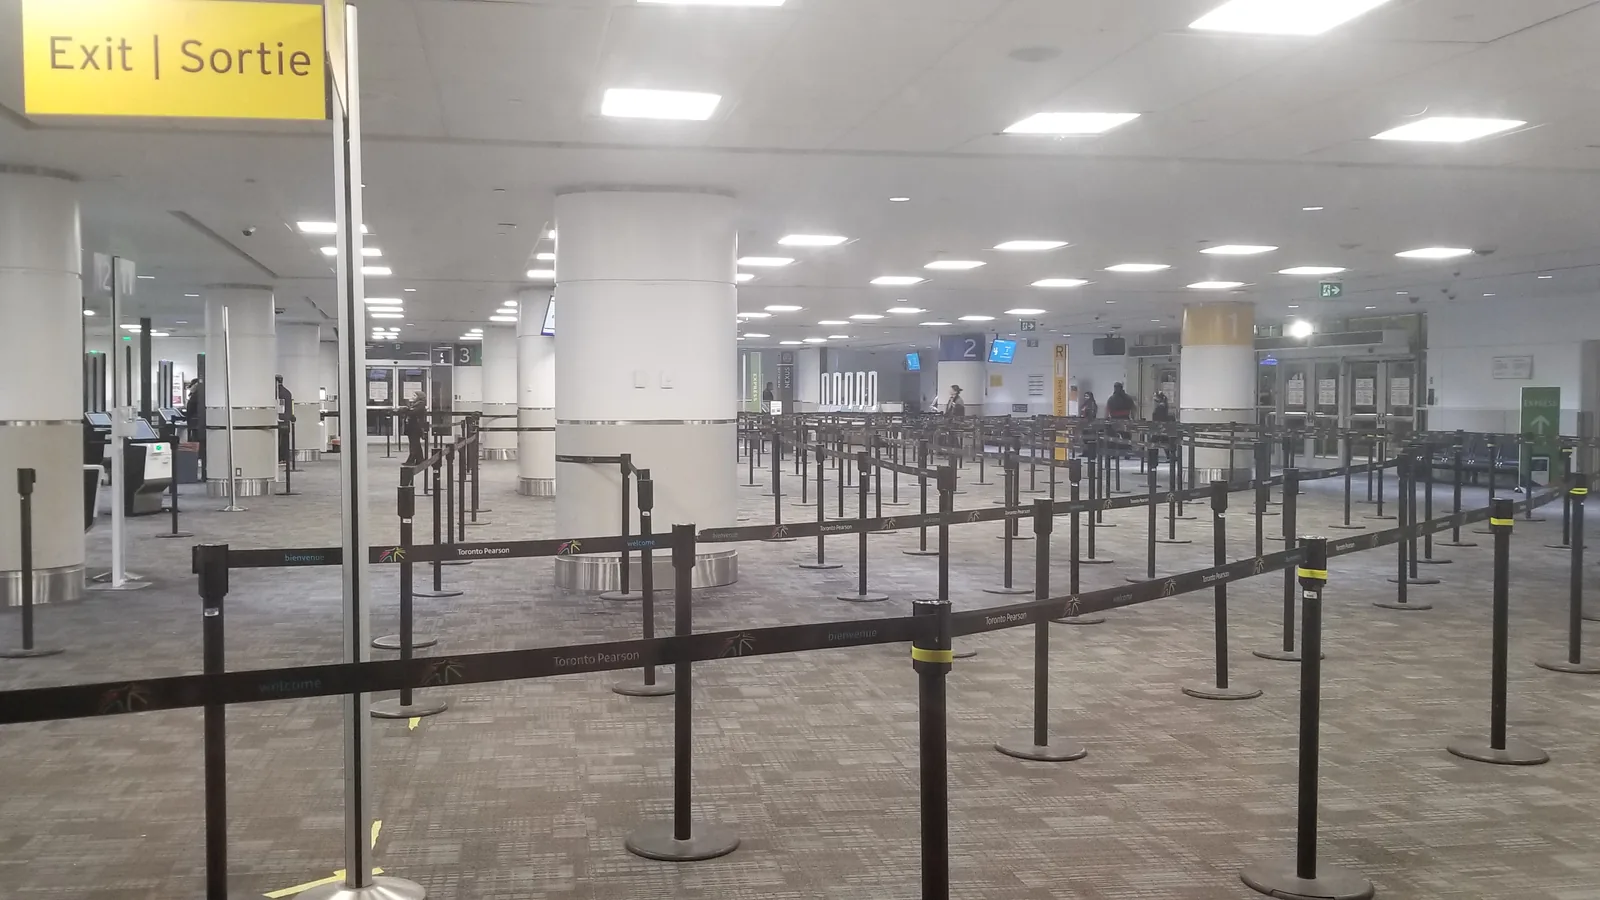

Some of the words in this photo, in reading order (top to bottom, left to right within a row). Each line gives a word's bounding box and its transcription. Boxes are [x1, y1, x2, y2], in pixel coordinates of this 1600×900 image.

[50, 35, 133, 71] Exit
[180, 38, 311, 76] Sortie
[963, 339, 976, 357] 2
[1056, 345, 1064, 358] R
[460, 348, 470, 363] 3
[1524, 399, 1558, 407] EXPRESS
[627, 539, 655, 547] welcome
[284, 553, 325, 562] bienvenue
[457, 548, 483, 556] Toronto
[483, 547, 510, 555] Pearson
[984, 615, 1007, 626] Toronto
[1006, 612, 1027, 623] Pearson
[828, 629, 877, 641] bienvenue
[553, 655, 596, 667] Toronto
[597, 651, 640, 663] Pearson
